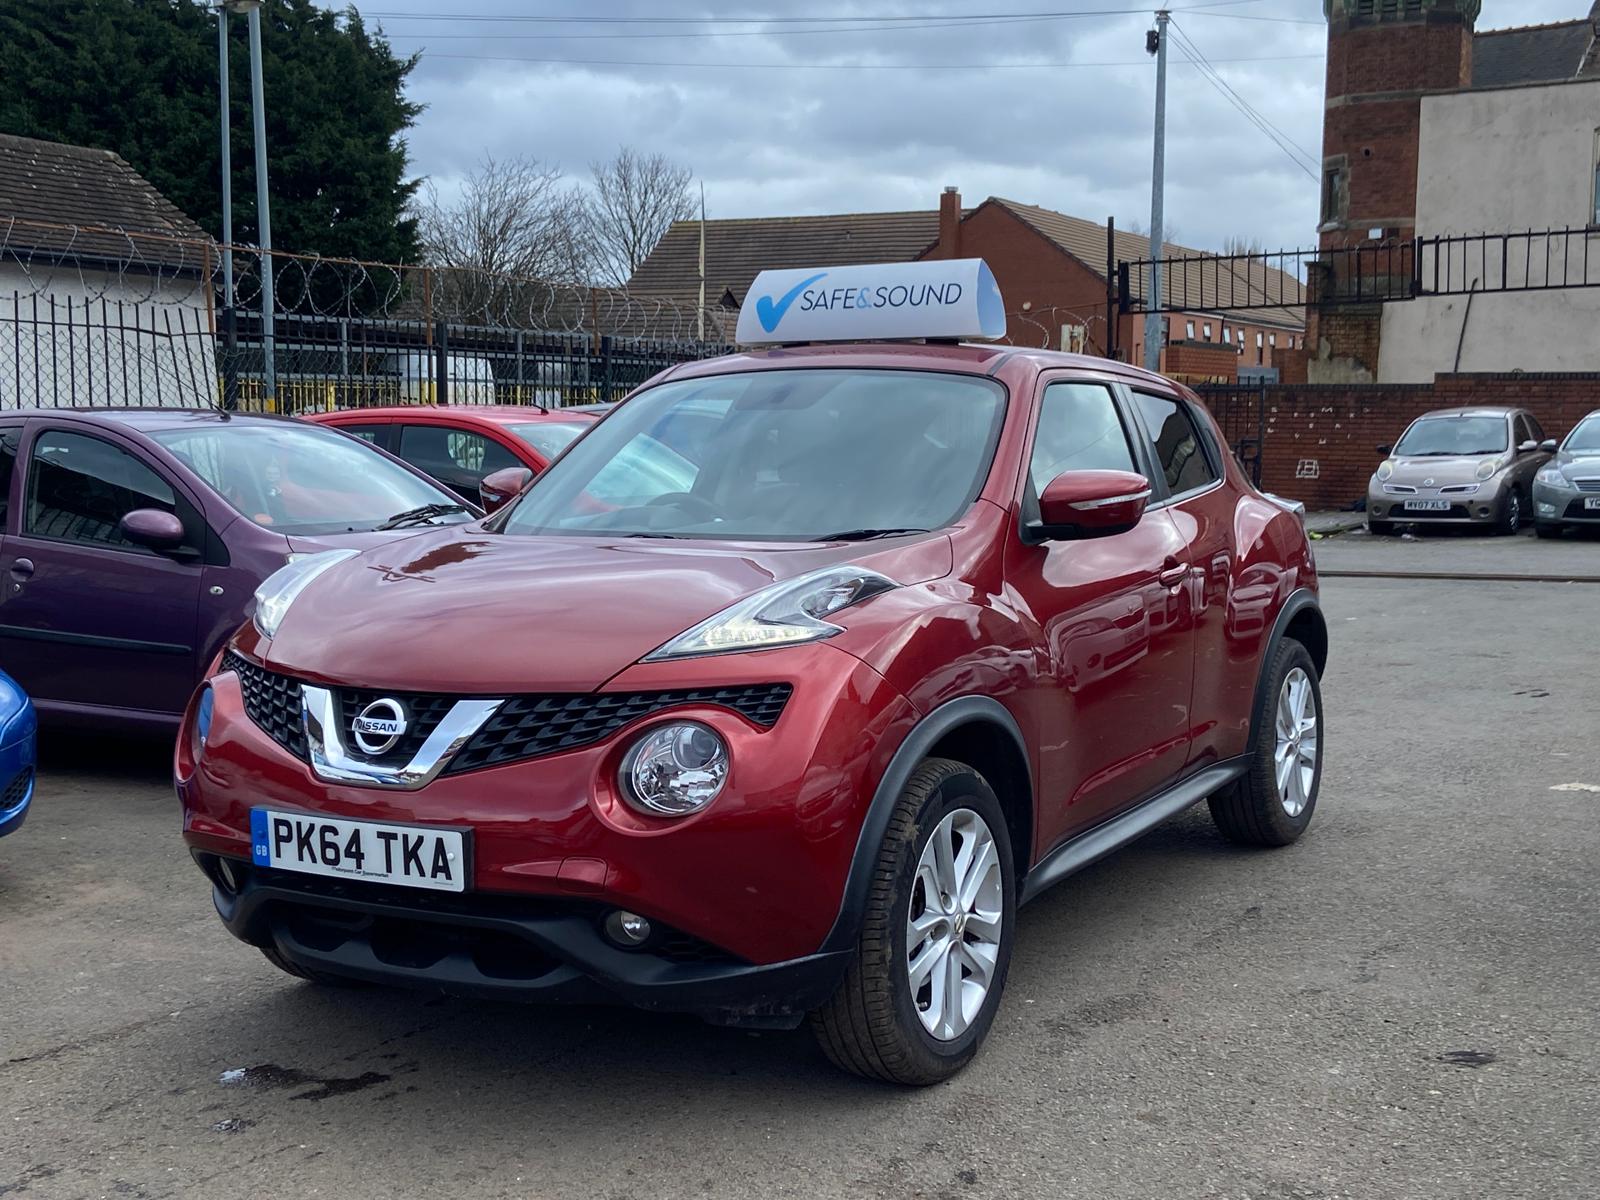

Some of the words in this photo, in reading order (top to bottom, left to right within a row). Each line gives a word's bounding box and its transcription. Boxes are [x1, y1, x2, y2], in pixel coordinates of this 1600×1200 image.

[801, 283, 962, 311] SAFE&SOUND
[354, 718, 398, 732] NISSAN
[255, 844, 268, 857] GB
[273, 817, 365, 870] PK64
[376, 830, 453, 881] TKA
